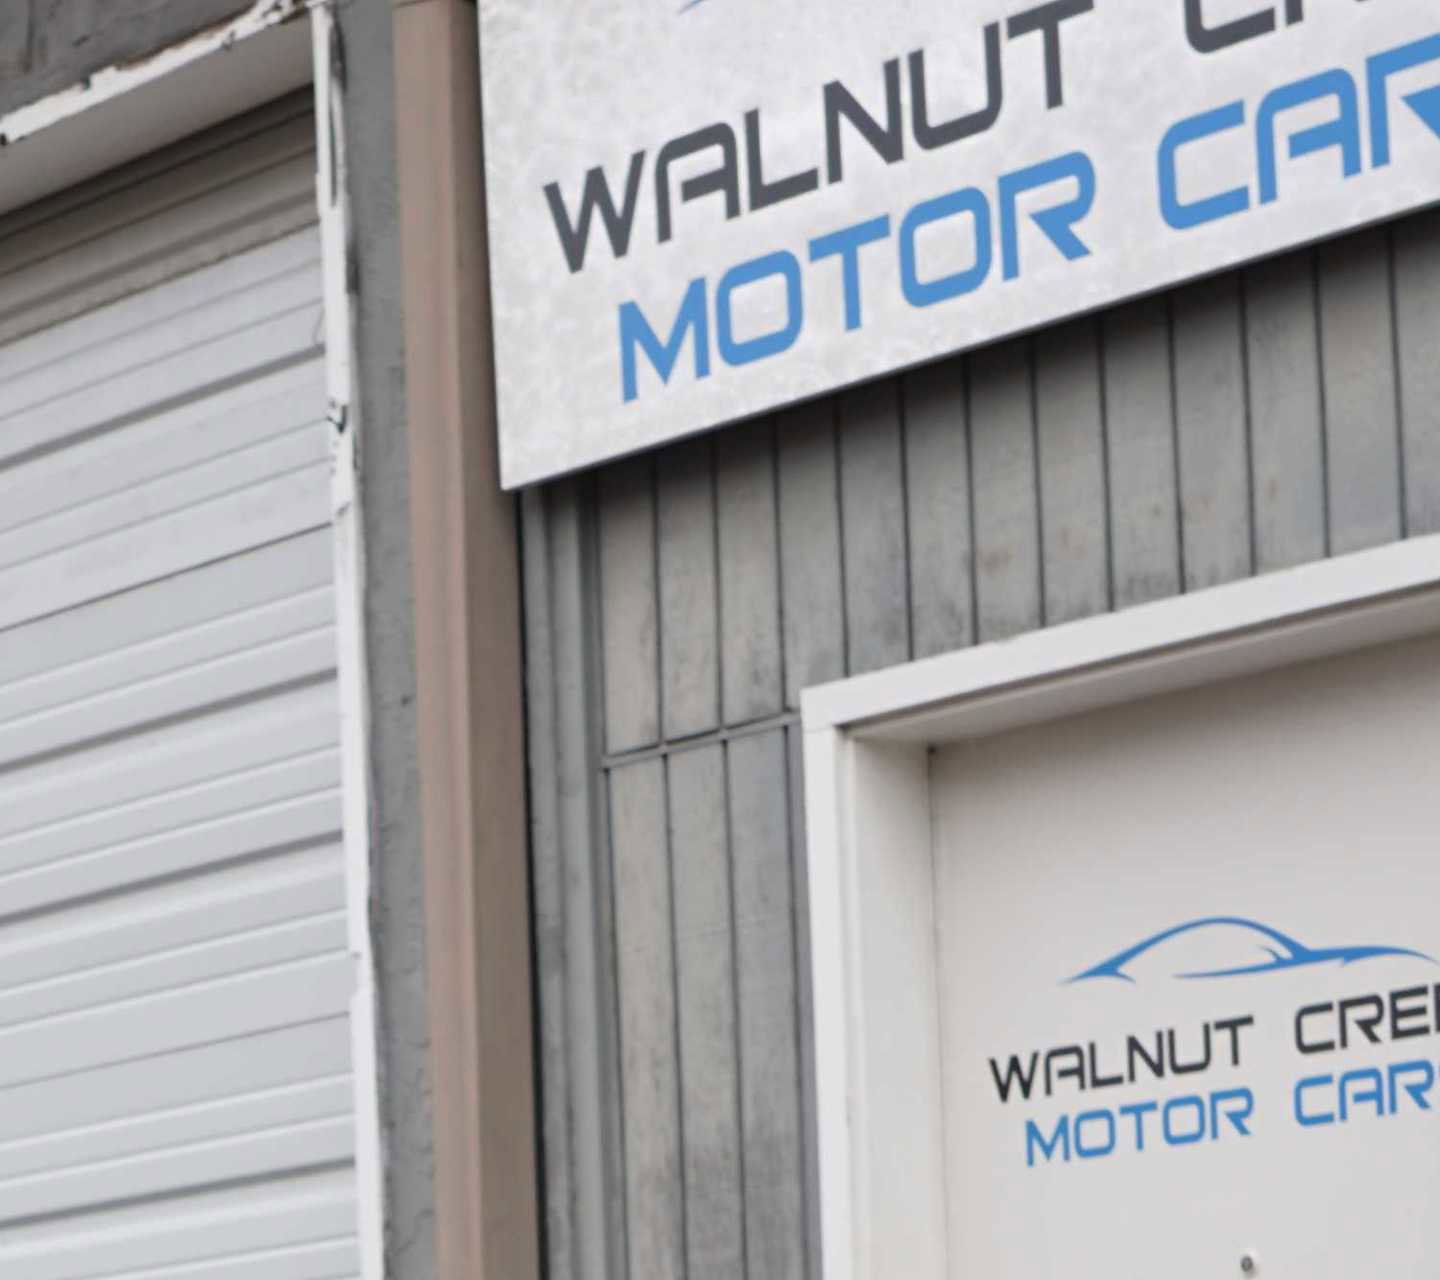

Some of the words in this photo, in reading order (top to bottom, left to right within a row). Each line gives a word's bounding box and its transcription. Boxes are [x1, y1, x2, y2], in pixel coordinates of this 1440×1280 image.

[543, 0, 1095, 274] WALNUT
[616, 150, 1097, 403] MOTOR
[989, 1014, 1254, 1103] WALNUT
[1024, 1086, 1256, 1169] MOTOR
